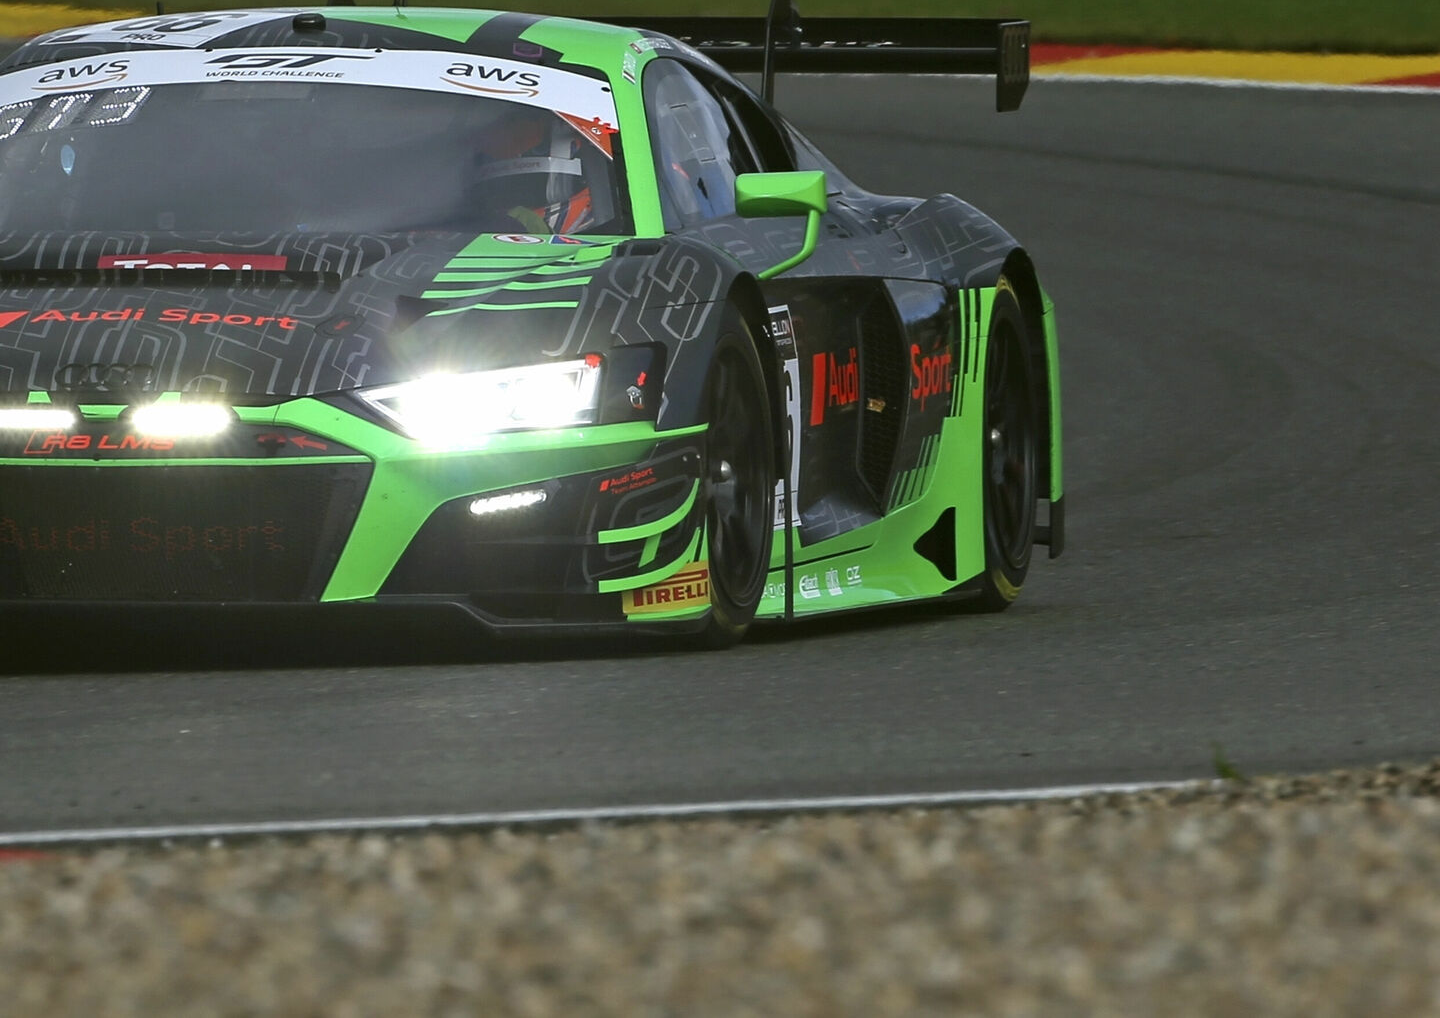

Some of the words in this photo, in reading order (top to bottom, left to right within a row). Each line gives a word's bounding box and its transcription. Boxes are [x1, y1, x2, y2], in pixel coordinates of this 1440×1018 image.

[120, 33, 167, 41] PRO
[38, 60, 131, 83] aws
[203, 53, 376, 69] GT
[261, 70, 345, 78] CHALLENGE
[446, 62, 541, 87] aws
[30, 308, 146, 323] Audi
[158, 309, 300, 330] Sport
[828, 347, 859, 407] Audi
[910, 343, 952, 412] Sport
[41, 434, 92, 450] R8
[97, 435, 176, 450] LMS
[129, 517, 286, 561] Sport
